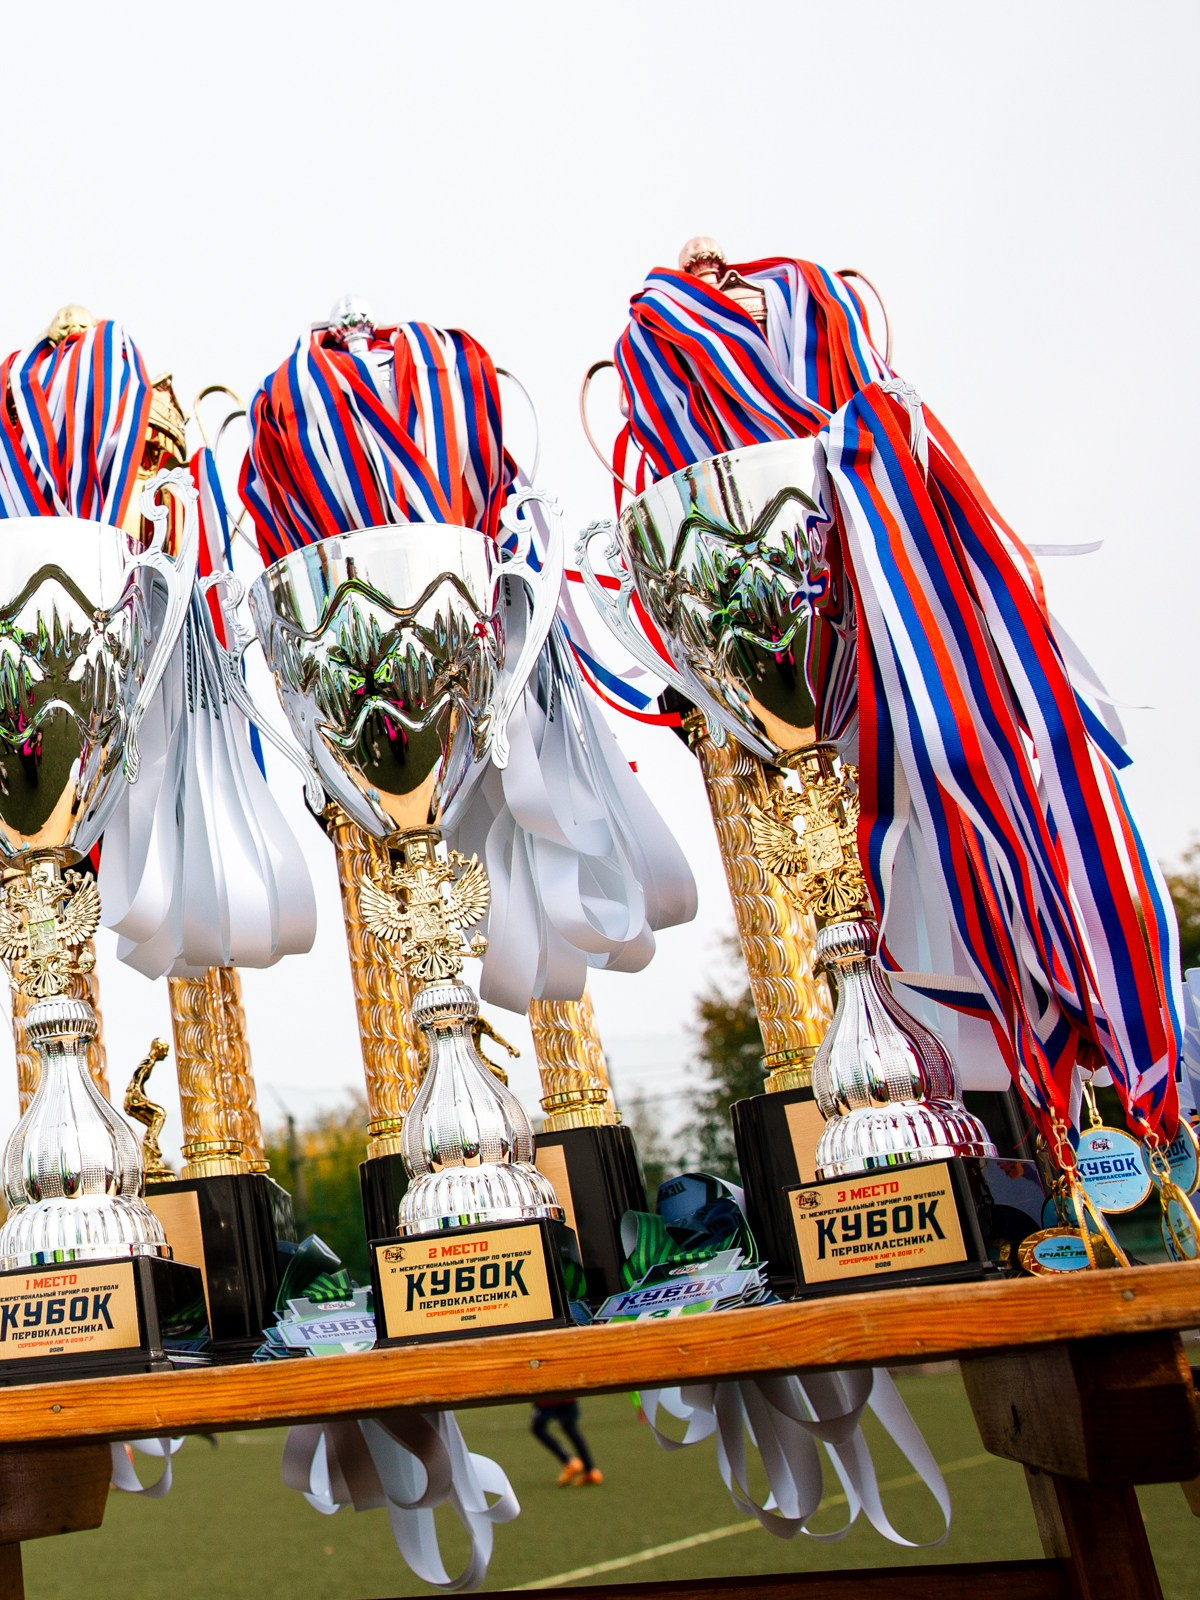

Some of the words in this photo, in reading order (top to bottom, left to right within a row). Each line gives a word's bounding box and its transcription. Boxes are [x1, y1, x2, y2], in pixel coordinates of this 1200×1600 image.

[836, 1190, 847, 1203] 3
[848, 1180, 900, 1201] МЕСТО
[808, 1201, 874, 1218] МЕЖРЕГИОНАЛЬНЫЙ
[876, 1196, 901, 1206] ТУРНИР
[913, 1189, 945, 1200] ФУТБОЛУ
[814, 1198, 947, 1260] КУБОК
[427, 1247, 437, 1259] 2
[440, 1240, 489, 1257] МЕСТО
[830, 1233, 933, 1257] ПЕРВОКЛАССНИКА
[399, 1258, 464, 1272] МЕЖРЕГИОНАЛЬНЫЙ
[465, 1255, 490, 1263] ТУРНИР
[501, 1249, 532, 1259] ФУТБОЛУ
[838, 1254, 878, 1266] СЕРЕБРЯНАЯ
[879, 1251, 896, 1260] ЛИГА
[25, 1279, 30, 1290] 1
[32, 1274, 77, 1289] МЕСТО
[58, 1288, 80, 1296] ТУРНИР
[91, 1284, 119, 1292] ФУТБОЛУ
[404, 1258, 530, 1312] КУБОК
[418, 1290, 517, 1310] ПЕРВОКЛАССНИКА
[616, 1278, 727, 1312] КУБОК
[627, 1291, 714, 1310] ПЕРВОКЛАССНИКА
[425, 1308, 464, 1318] СЕРЕБРЯНАЯ
[11, 1323, 103, 1340] ПЕРВОКЛАССНИКА
[17, 1340, 52, 1349] СЕРЕБРЯНАЯ
